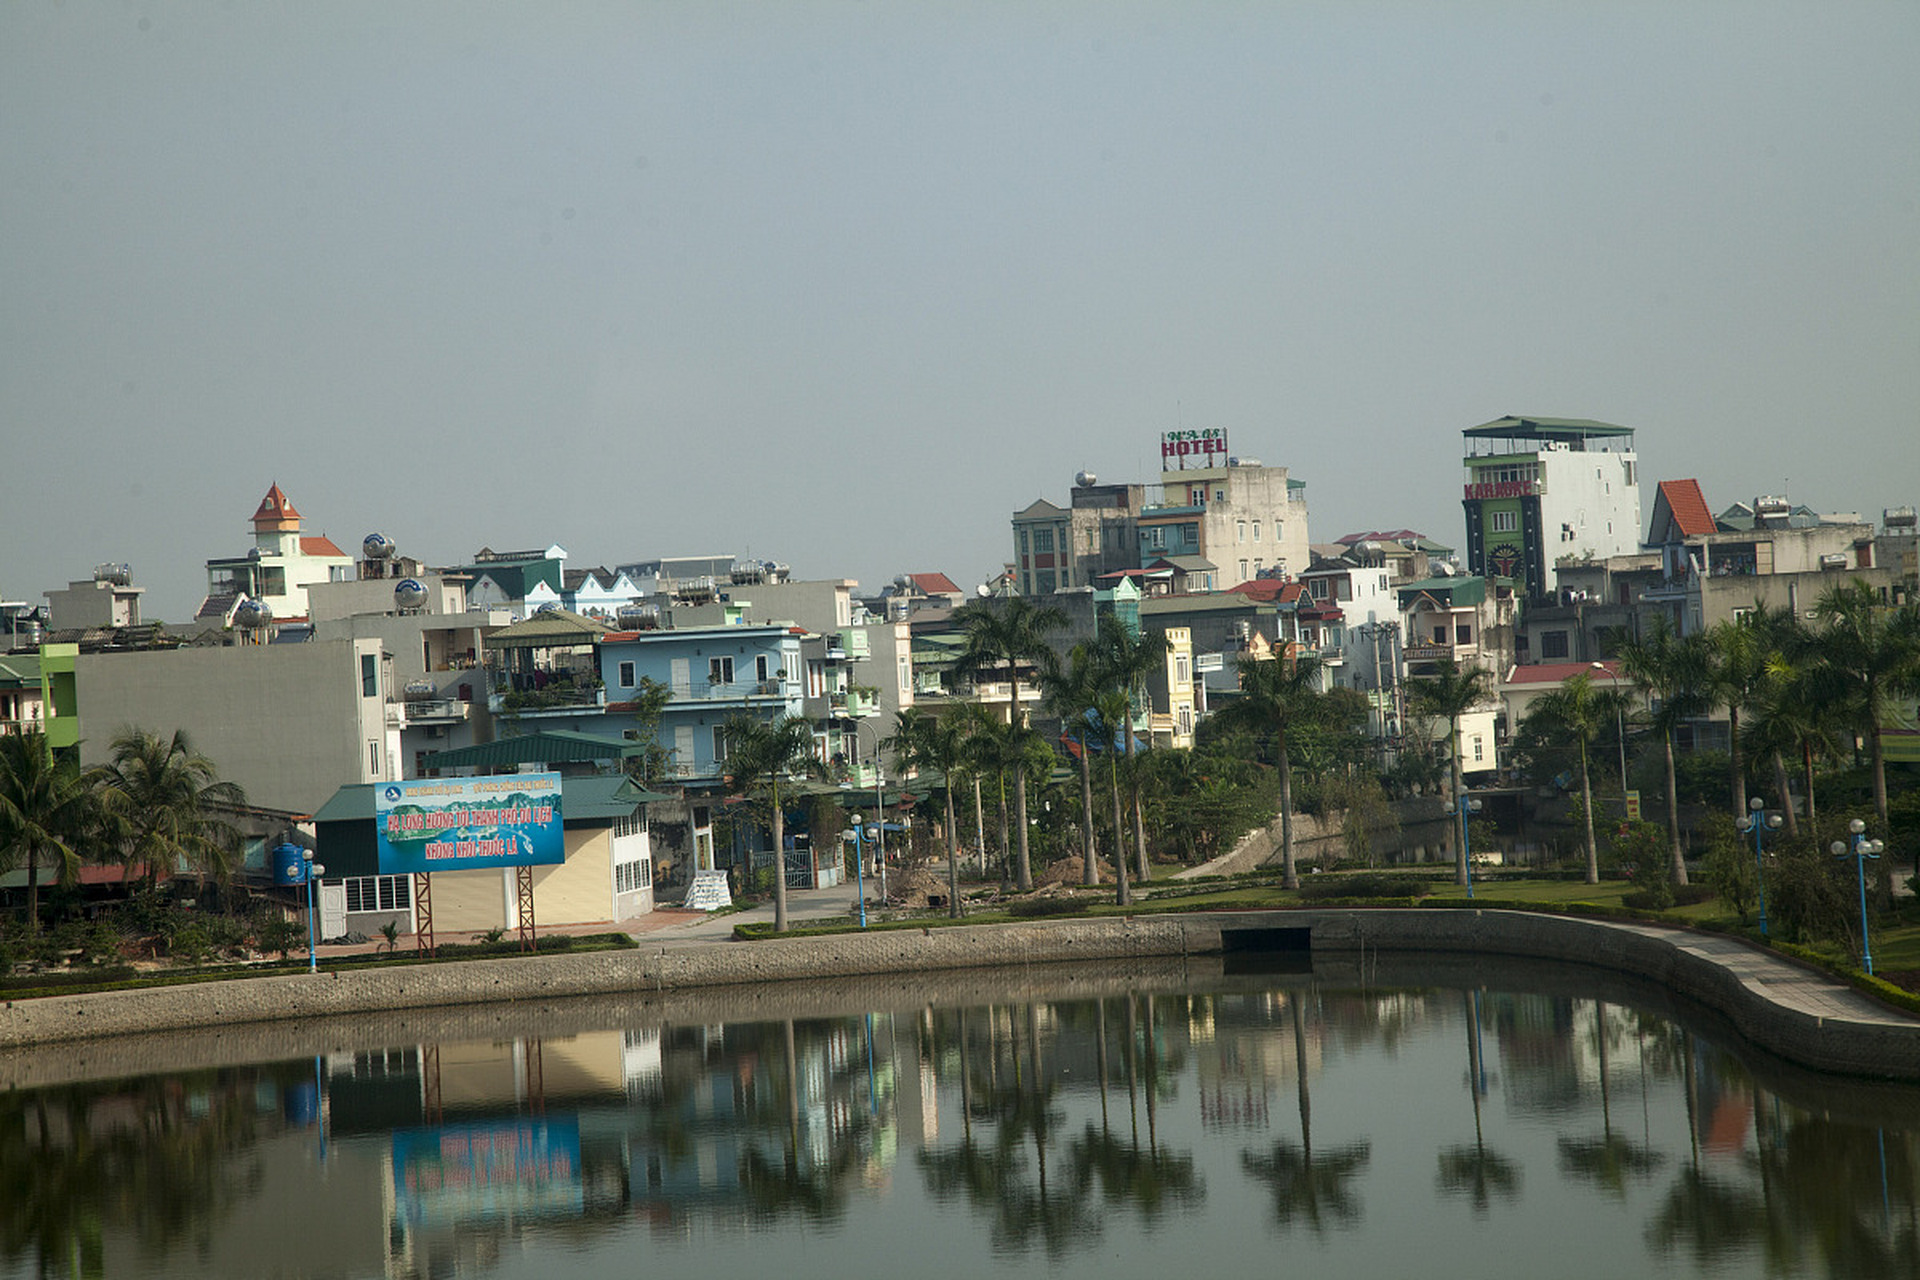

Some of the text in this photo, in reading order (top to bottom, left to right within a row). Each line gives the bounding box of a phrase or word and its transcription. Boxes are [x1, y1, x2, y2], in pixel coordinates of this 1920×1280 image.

[1162, 438, 1228, 457] HOTEL
[1464, 480, 1532, 499] KARAOKE
[387, 814, 400, 834] HẠ
[401, 813, 423, 830] LONG
[425, 807, 454, 829] HƯỚNG
[519, 807, 532, 823] DU
[533, 805, 552, 826] LỊCH
[506, 833, 519, 855] LÁ
